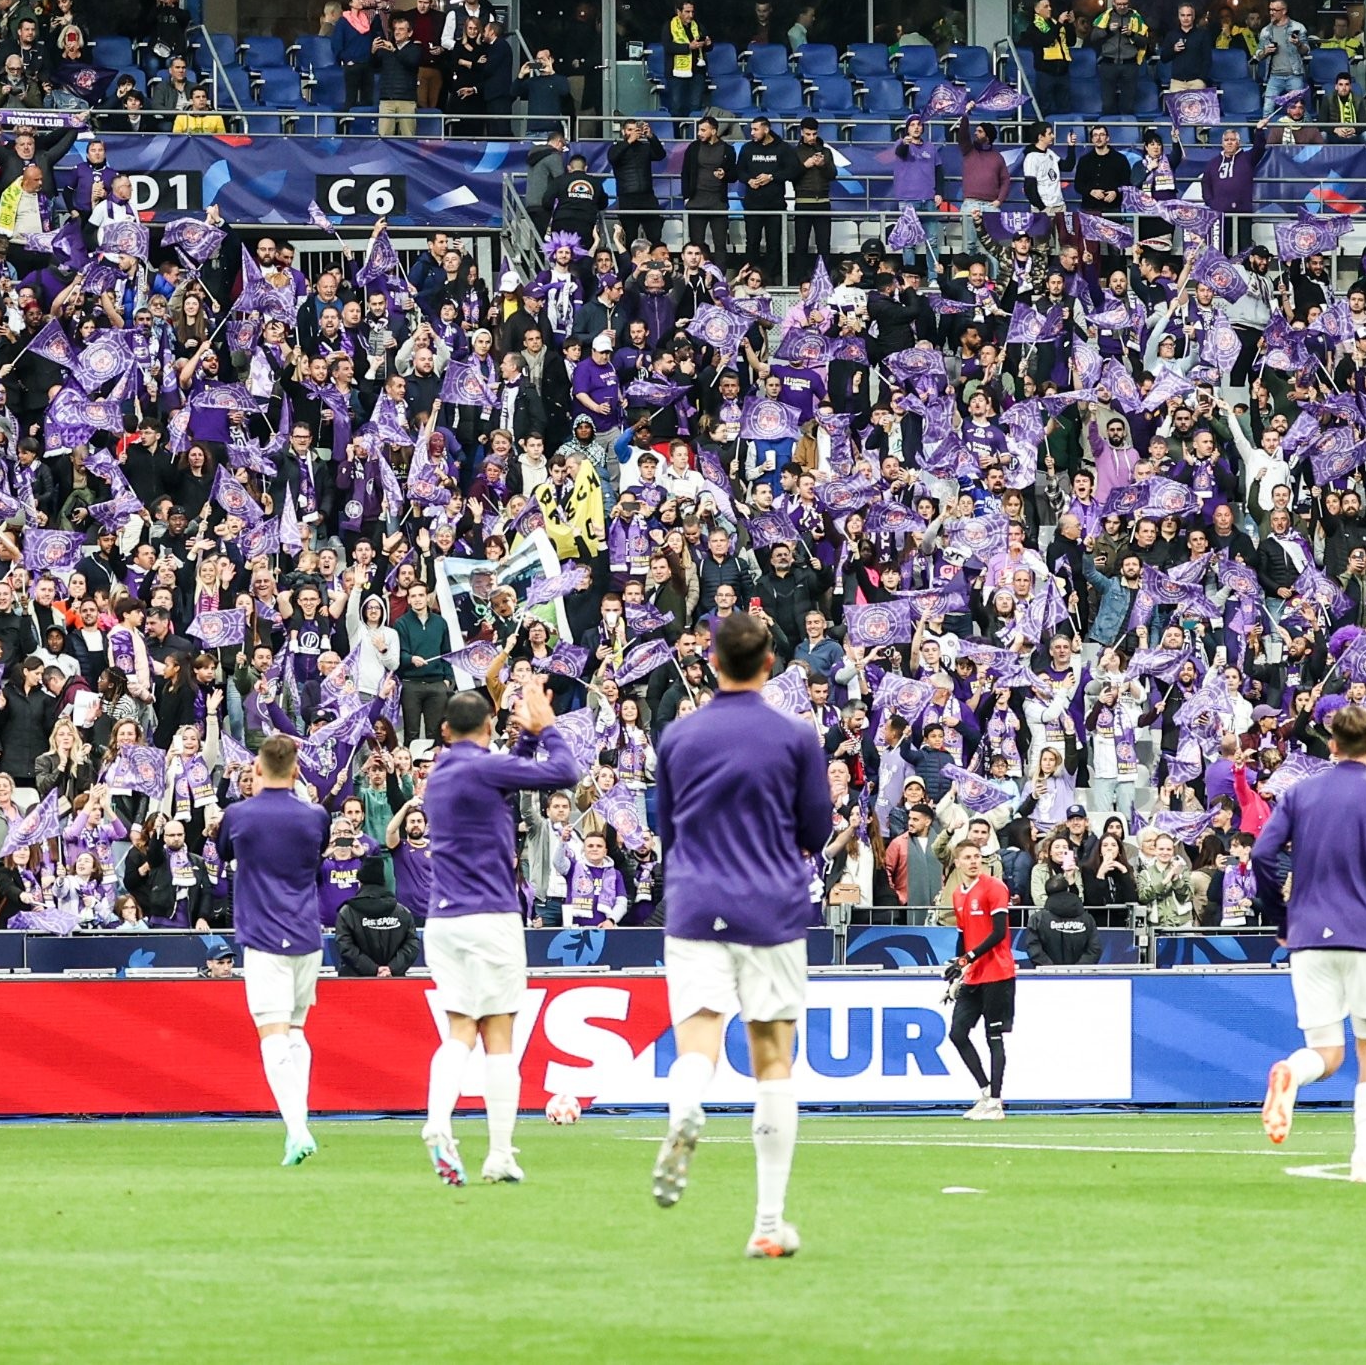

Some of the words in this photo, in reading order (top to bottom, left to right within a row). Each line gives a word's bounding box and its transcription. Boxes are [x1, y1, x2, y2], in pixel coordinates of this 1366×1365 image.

[6, 116, 44, 126] FOOTBALL
[44, 118, 65, 127] CLUB
[1050, 920, 1087, 933] Gest'SPORT
